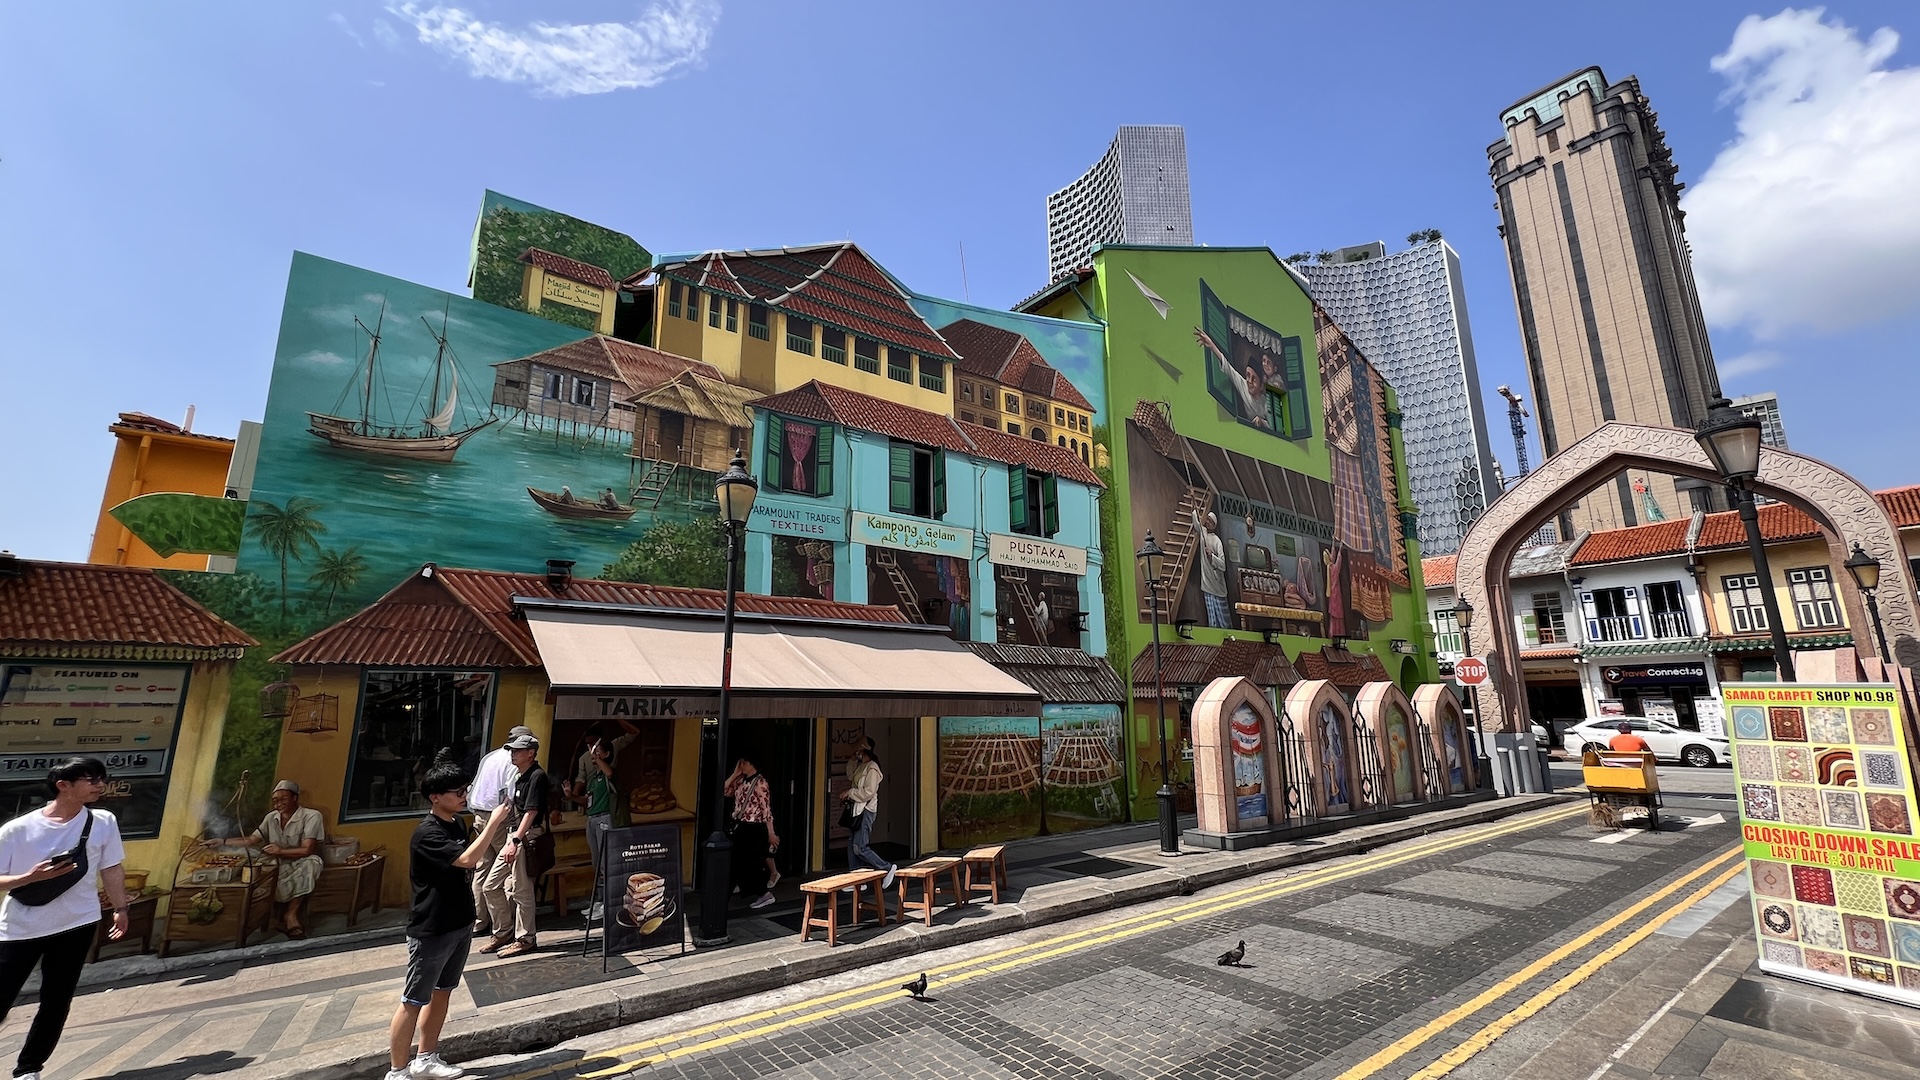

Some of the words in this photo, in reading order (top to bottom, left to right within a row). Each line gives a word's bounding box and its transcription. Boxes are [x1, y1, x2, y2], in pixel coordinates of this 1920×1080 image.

[547, 278, 570, 290] Masjid
[574, 285, 599, 299] Sultan
[752, 505, 800, 519] ARAMOUNT
[805, 511, 841, 525] TRADERS
[770, 519, 824, 534] TEXTILES
[867, 516, 917, 537] Kampong
[925, 527, 956, 542] Gelam
[1009, 541, 1066, 560] PUSTAKA
[999, 553, 1016, 561] HAJI
[1020, 556, 1060, 568] MUHAMMAD
[1064, 561, 1079, 571] SAID
[54, 670, 118, 678] FEATURED
[121, 671, 139, 679] ON
[1456, 665, 1486, 678] STOP
[1621, 667, 1704, 678] TravelConnect.sg
[1725, 690, 1766, 701] SAMAD
[1768, 690, 1813, 701] CARPET
[1816, 691, 1851, 702] SHOP
[1854, 691, 1895, 703] NO.98
[598, 698, 678, 716] TARIK
[1744, 825, 1811, 848] CLOSING
[1814, 833, 1868, 854] DOWN
[1871, 838, 1920, 860] SALE
[1771, 845, 1798, 859] LAST
[1802, 849, 1829, 864] DATE
[1839, 853, 1855, 867] 30
[1859, 858, 1896, 872] APRIL
